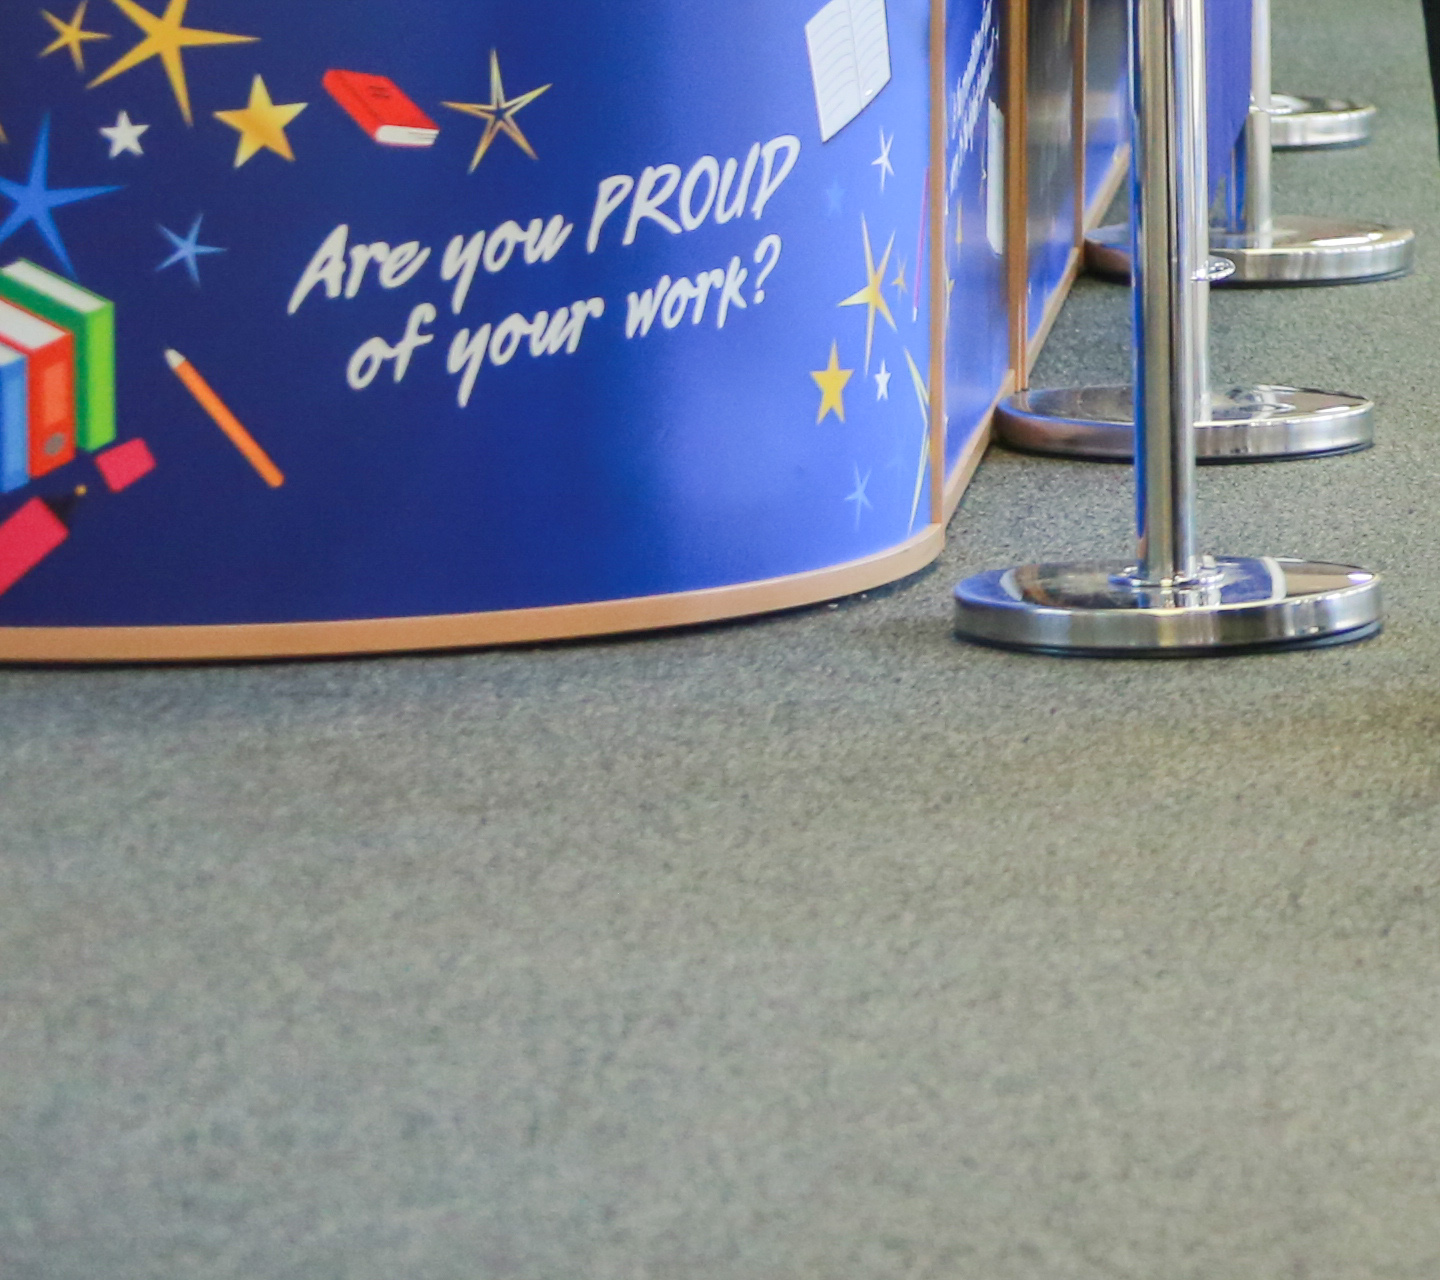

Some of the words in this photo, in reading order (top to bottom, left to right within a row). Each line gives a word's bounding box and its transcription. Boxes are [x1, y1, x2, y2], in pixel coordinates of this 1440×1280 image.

[287, 223, 432, 316] Are
[440, 212, 574, 312] you
[586, 135, 801, 253] PROUD
[347, 302, 437, 391] of
[447, 293, 606, 408] your
[624, 234, 783, 341] work?
